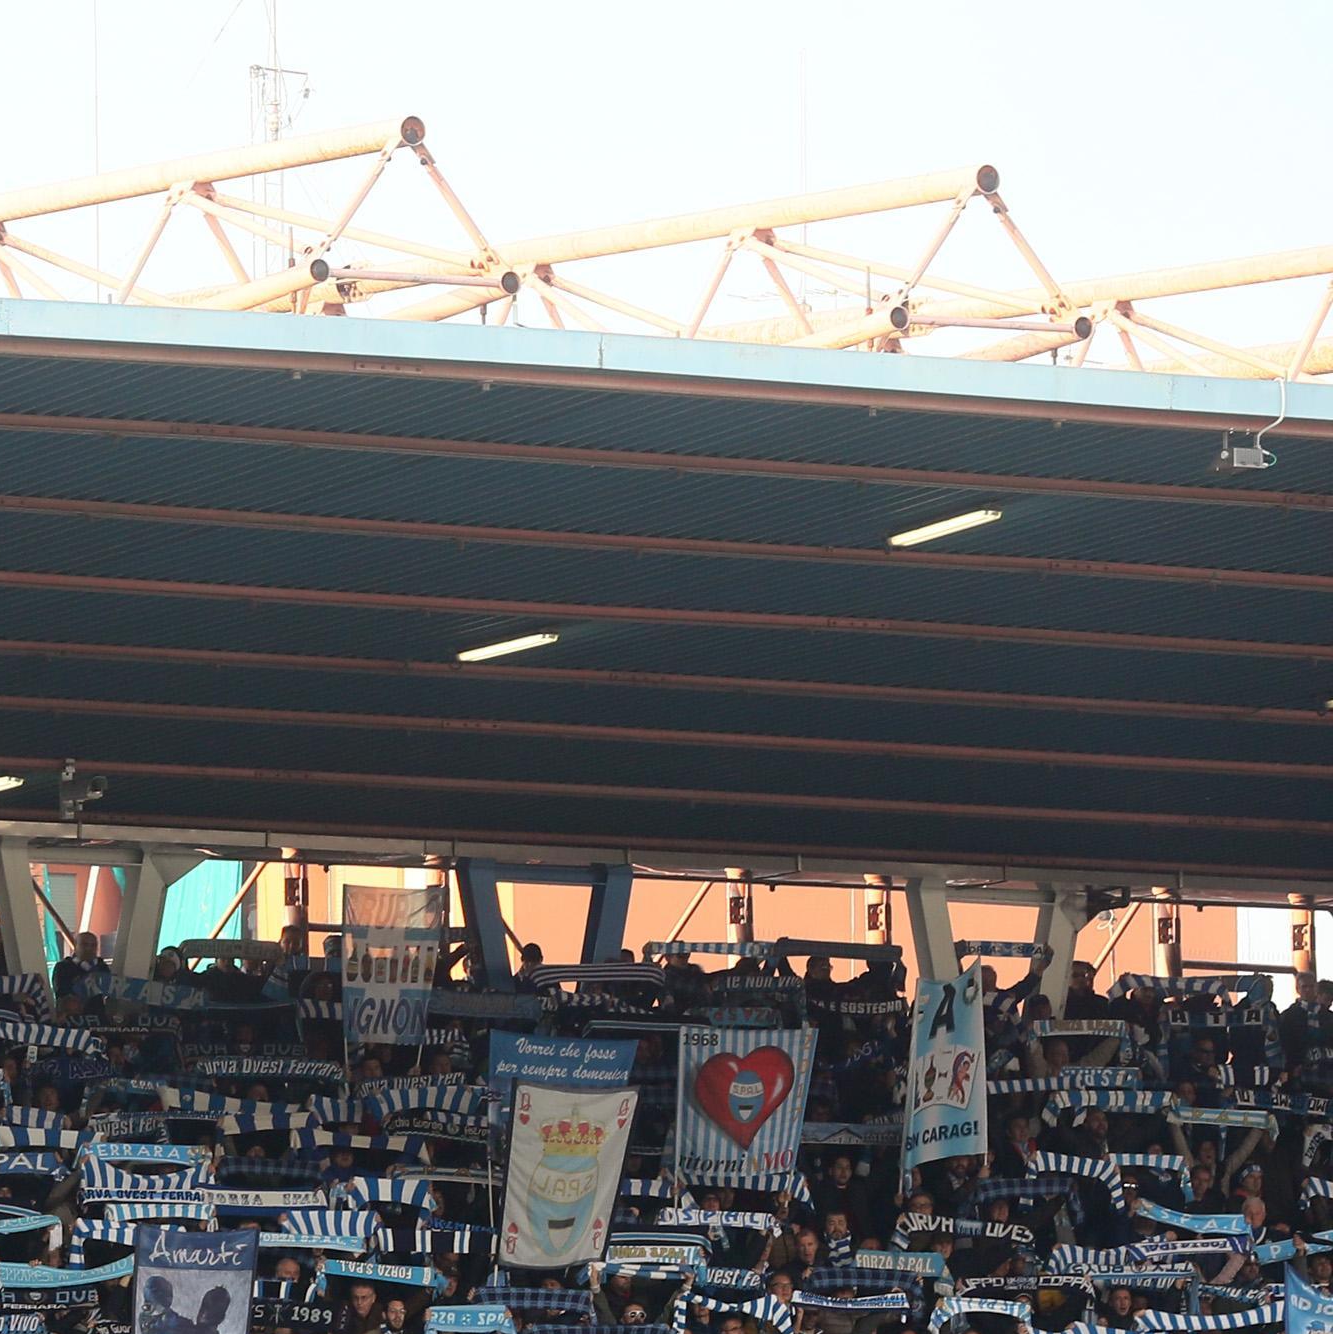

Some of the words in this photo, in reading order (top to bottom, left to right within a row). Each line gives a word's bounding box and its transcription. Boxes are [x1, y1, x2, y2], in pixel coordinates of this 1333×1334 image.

[682, 1031, 719, 1046] 1968
[516, 1037, 555, 1056] Vorrei
[560, 1040, 580, 1058] che
[584, 1041, 617, 1062] fosse
[495, 1060, 518, 1080] per
[521, 1062, 566, 1080] sempre
[572, 1062, 629, 1081] domenica
[922, 1120, 980, 1145] CARAG!
[856, 1255, 893, 1270] FORZA
[291, 1305, 333, 1323] 1989
